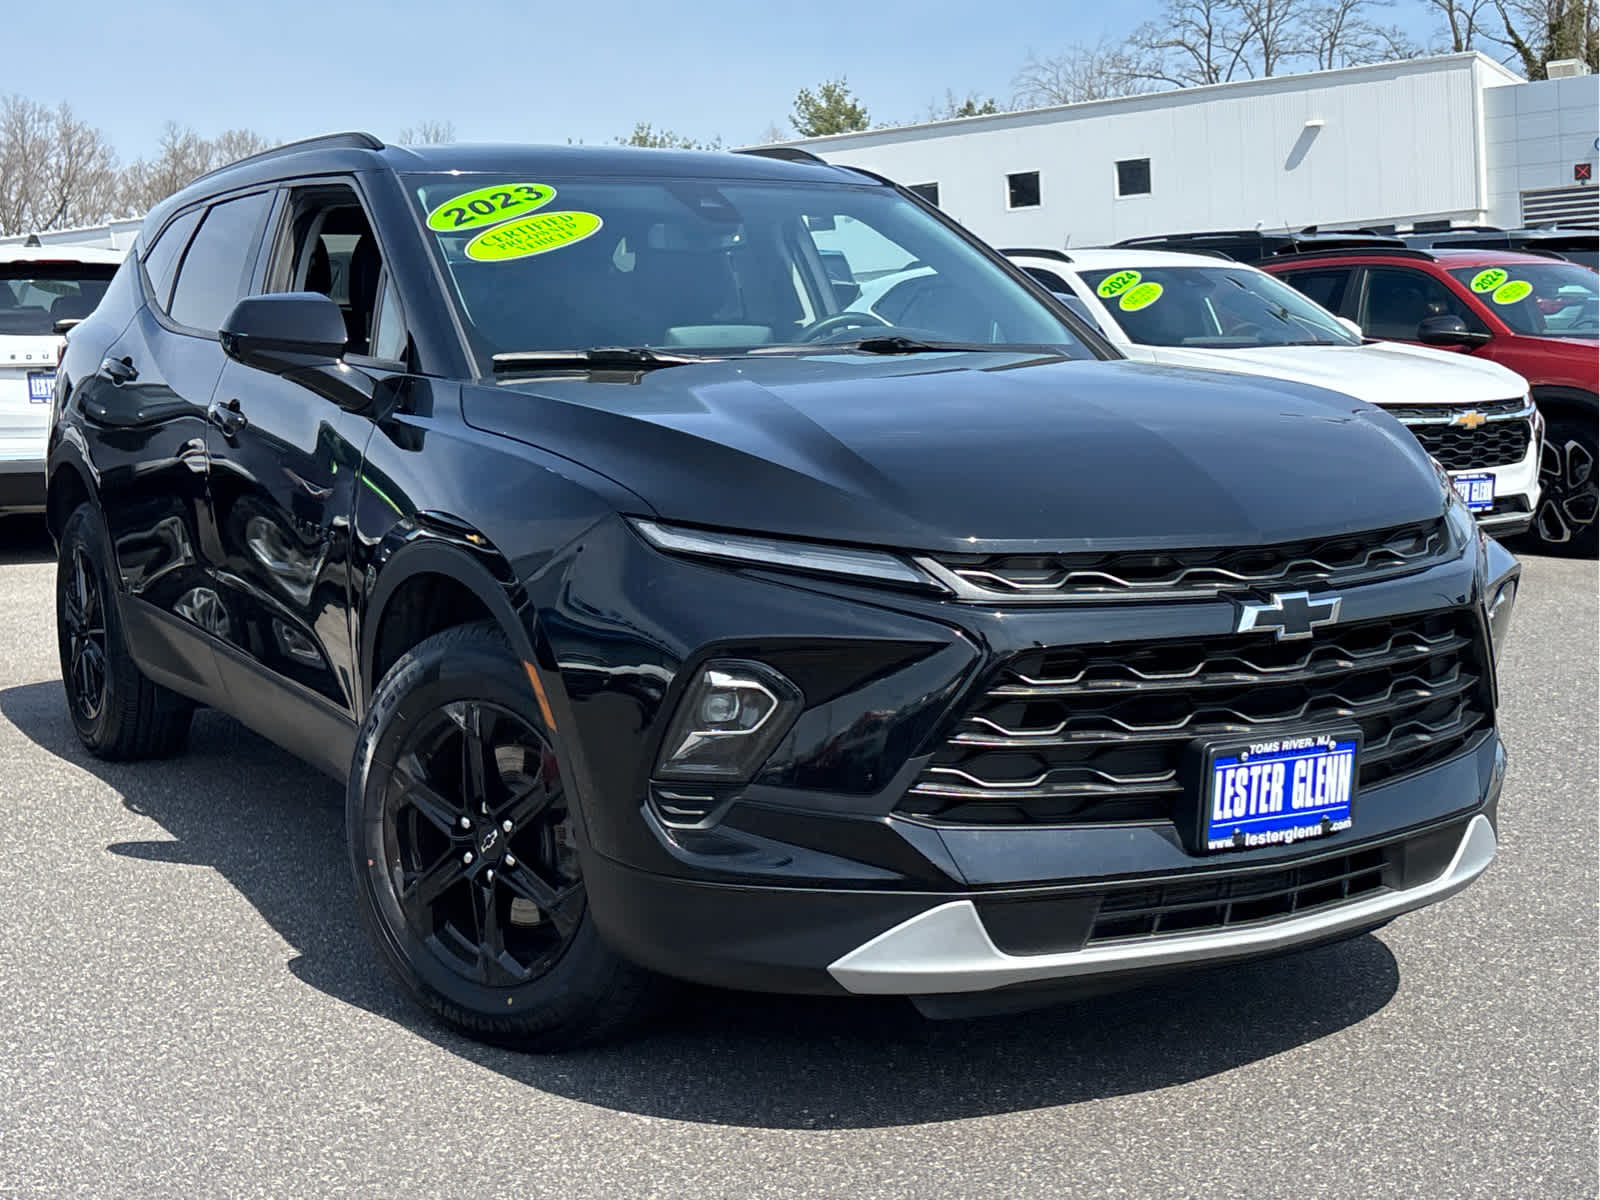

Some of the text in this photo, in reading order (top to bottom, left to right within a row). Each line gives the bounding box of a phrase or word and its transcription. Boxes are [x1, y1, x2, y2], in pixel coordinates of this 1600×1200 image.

[442, 186, 543, 227] 2023
[480, 215, 574, 246] CERTIFIED
[1102, 272, 1137, 295] 2024
[1249, 741, 1280, 755] TOMS
[1317, 735, 1331, 746] NJ
[1212, 753, 1352, 821] LESTER GLENN
